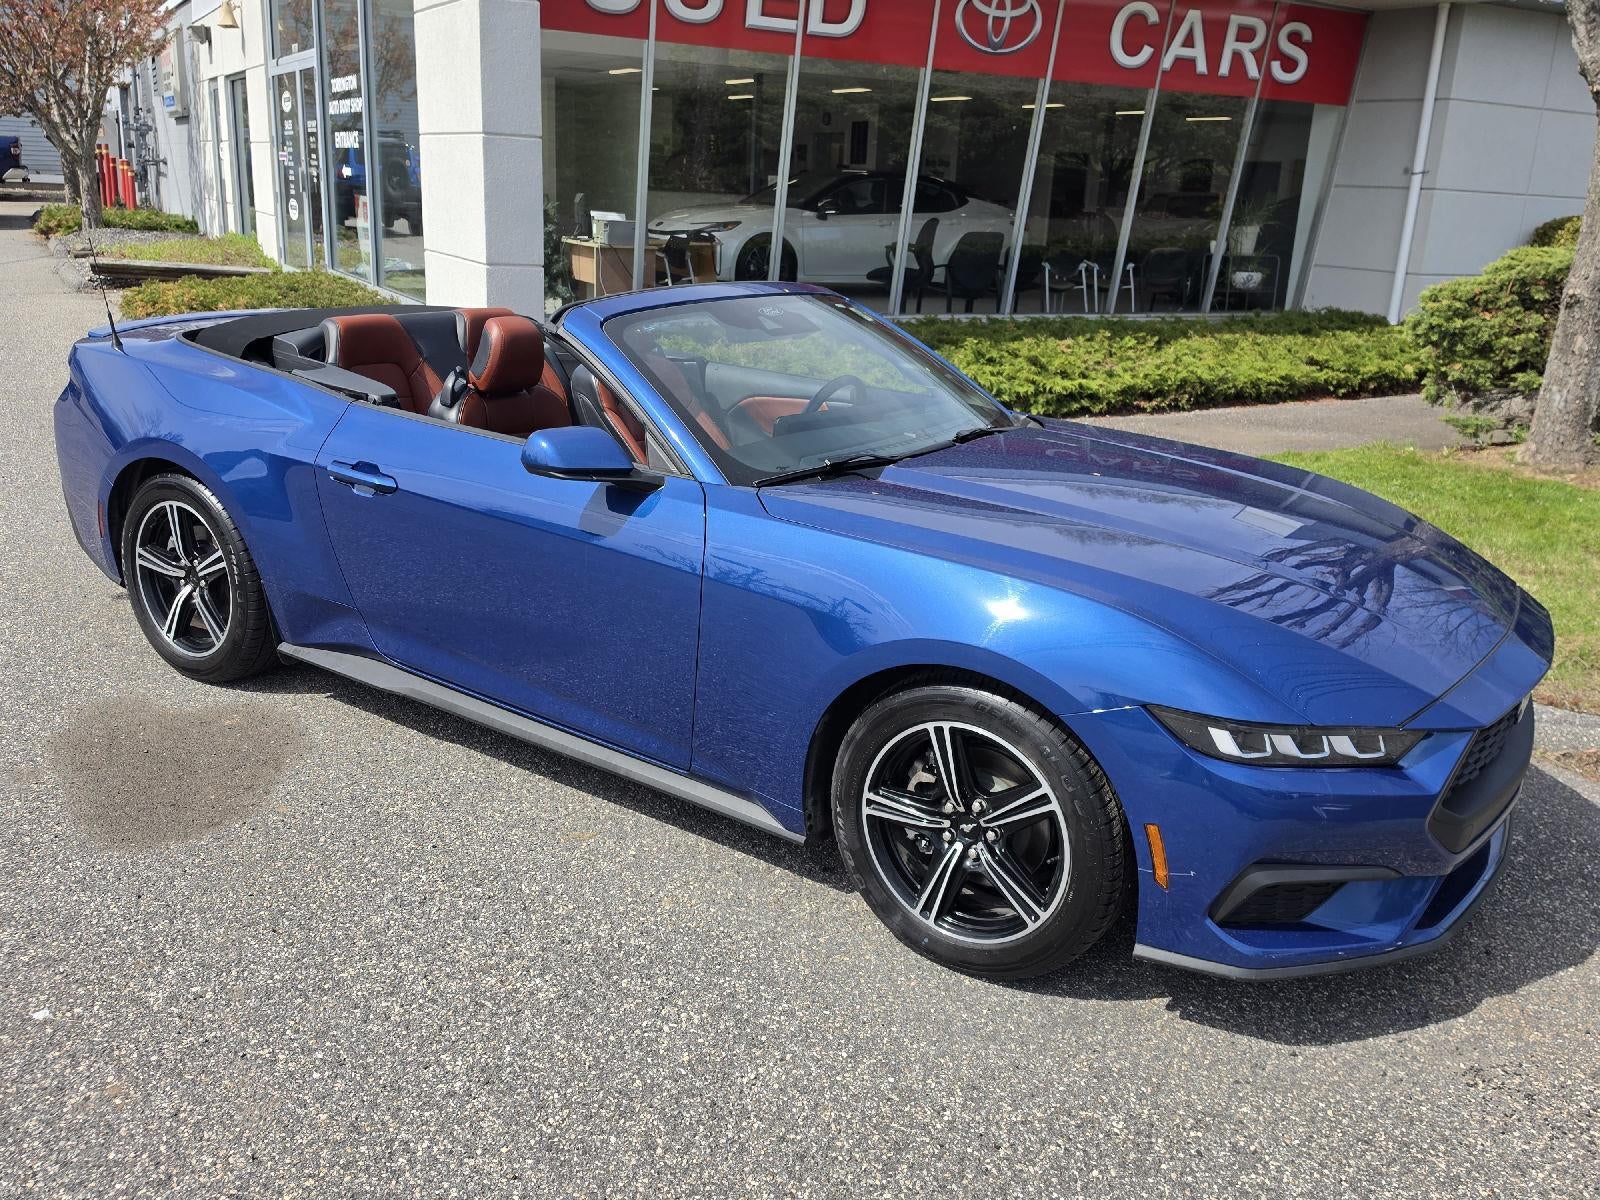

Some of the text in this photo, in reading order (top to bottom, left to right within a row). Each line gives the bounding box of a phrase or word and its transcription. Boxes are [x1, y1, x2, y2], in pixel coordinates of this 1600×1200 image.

[585, 0, 1313, 85] ED CARS
[335, 131, 359, 149] ENTRANCE
